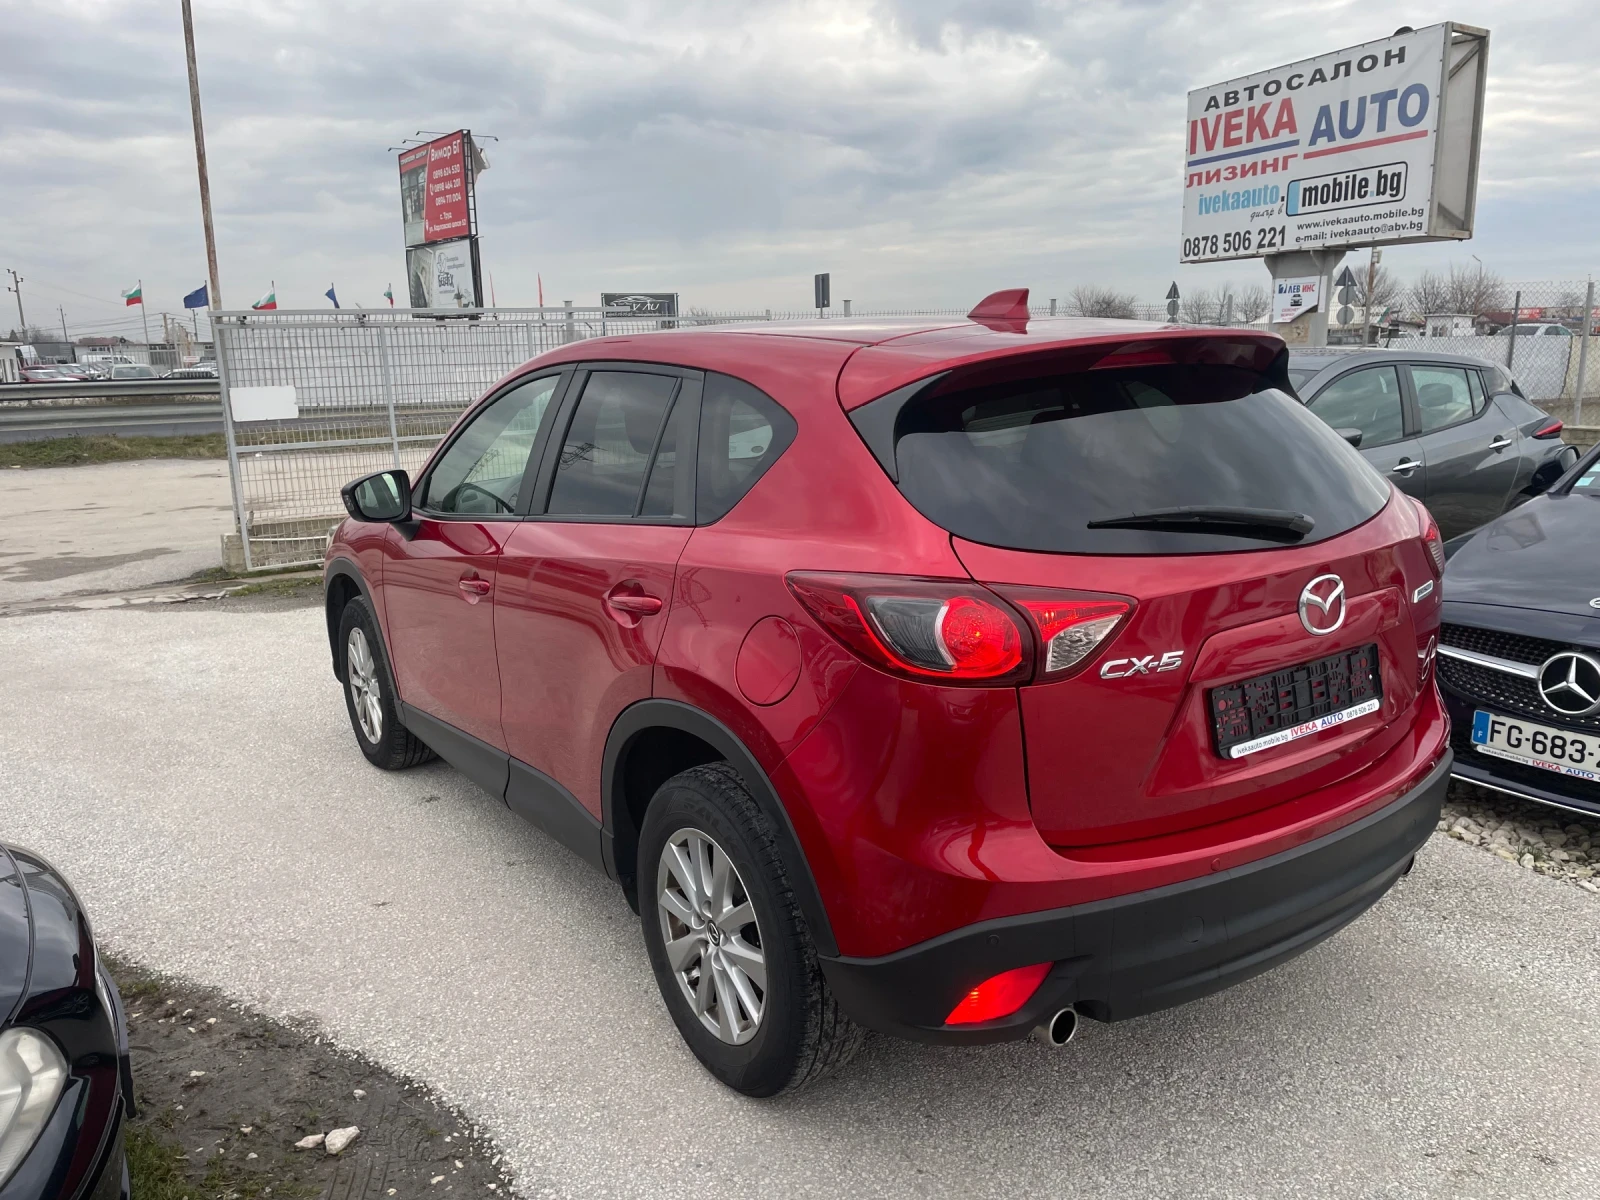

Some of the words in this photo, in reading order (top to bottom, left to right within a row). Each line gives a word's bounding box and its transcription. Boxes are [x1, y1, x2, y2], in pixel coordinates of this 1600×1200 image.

[1204, 46, 1406, 112] АВТОСАЛОН
[1190, 97, 1298, 155] IVEKA
[1308, 83, 1430, 147] AUTO
[1186, 154, 1298, 188] ЛИЗИНГ
[1302, 169, 1402, 207] mobile.bg
[1295, 231, 1328, 243] e-mail:
[1330, 220, 1423, 239] ivekaauto@abv.bg
[1297, 207, 1424, 230] www.ivekaauto.mobile.bg
[1184, 234, 1219, 257] 0878
[1223, 230, 1252, 253] 506
[1257, 225, 1286, 249] 221
[1288, 284, 1301, 293] ЛЕВ
[1302, 284, 1316, 293] ИНС
[1100, 650, 1184, 680] CX-5
[1290, 721, 1319, 737] IVEKA
[1321, 712, 1345, 728] AUTO
[1477, 730, 1483, 738] F
[1532, 759, 1562, 773] IVEKA
[1565, 767, 1595, 780] AUTO
